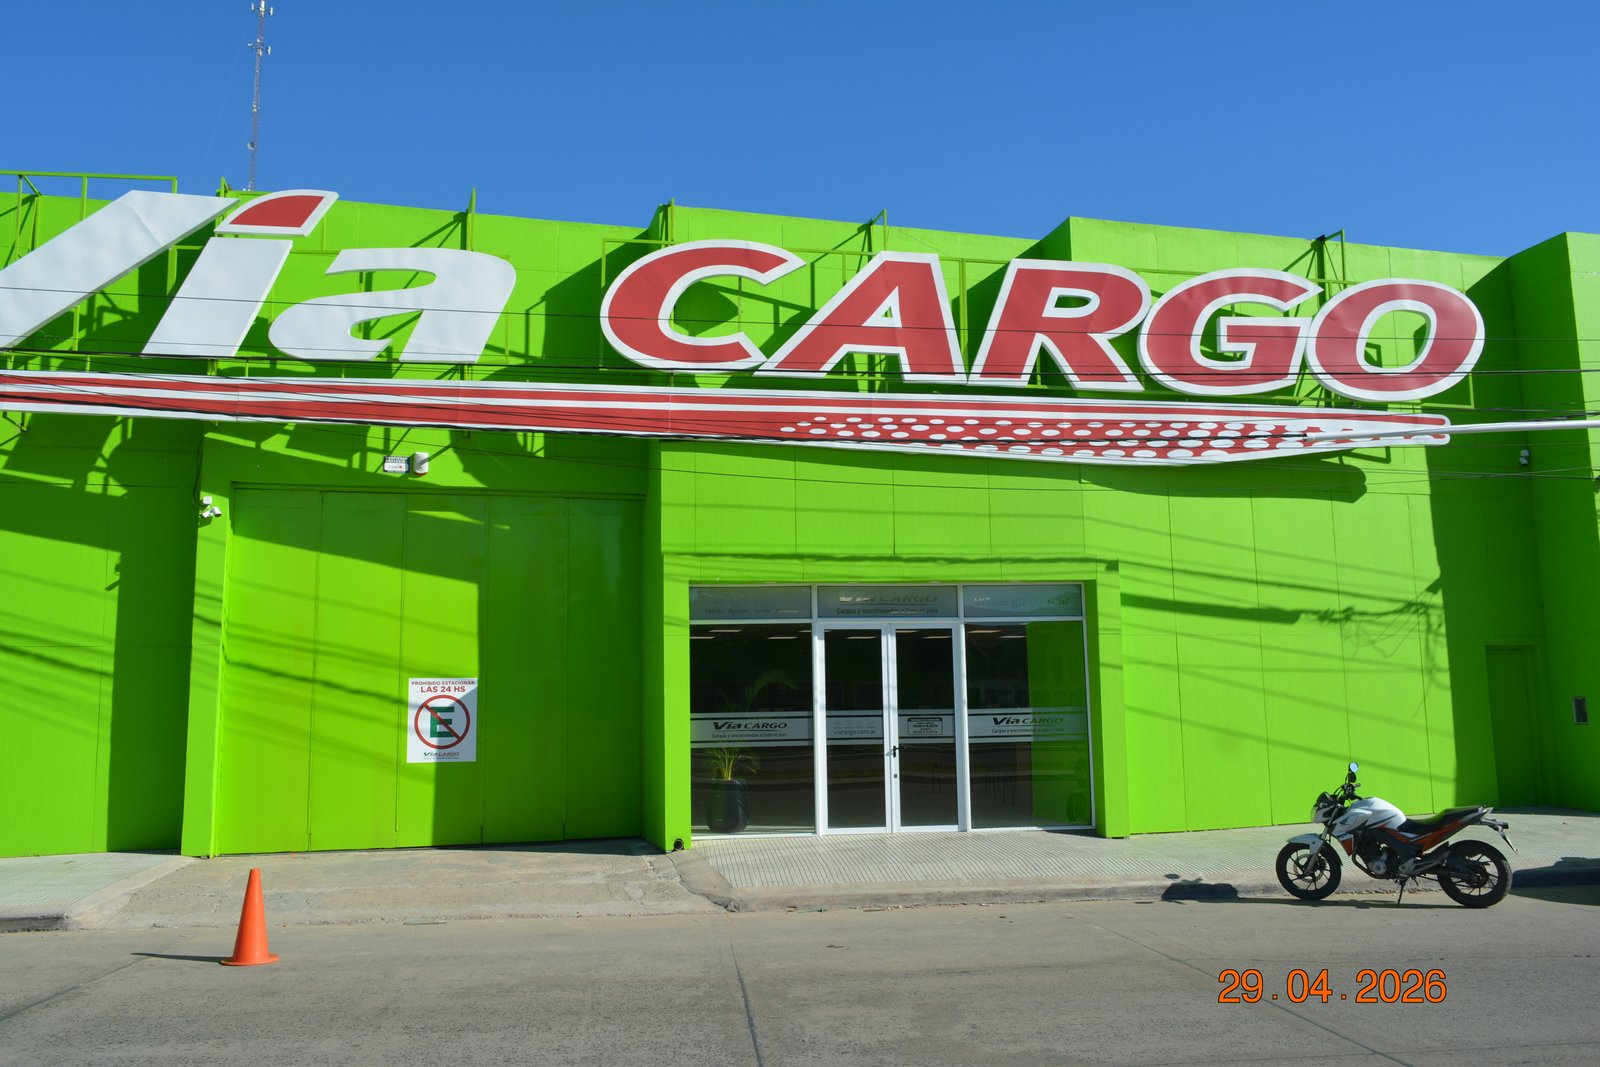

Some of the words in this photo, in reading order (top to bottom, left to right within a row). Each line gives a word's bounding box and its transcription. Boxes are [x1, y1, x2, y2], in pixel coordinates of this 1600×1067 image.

[600, 239, 1485, 400] CARGO
[713, 721, 742, 730] Via
[992, 716, 1020, 726] Via
[1022, 717, 1064, 725] CARGO
